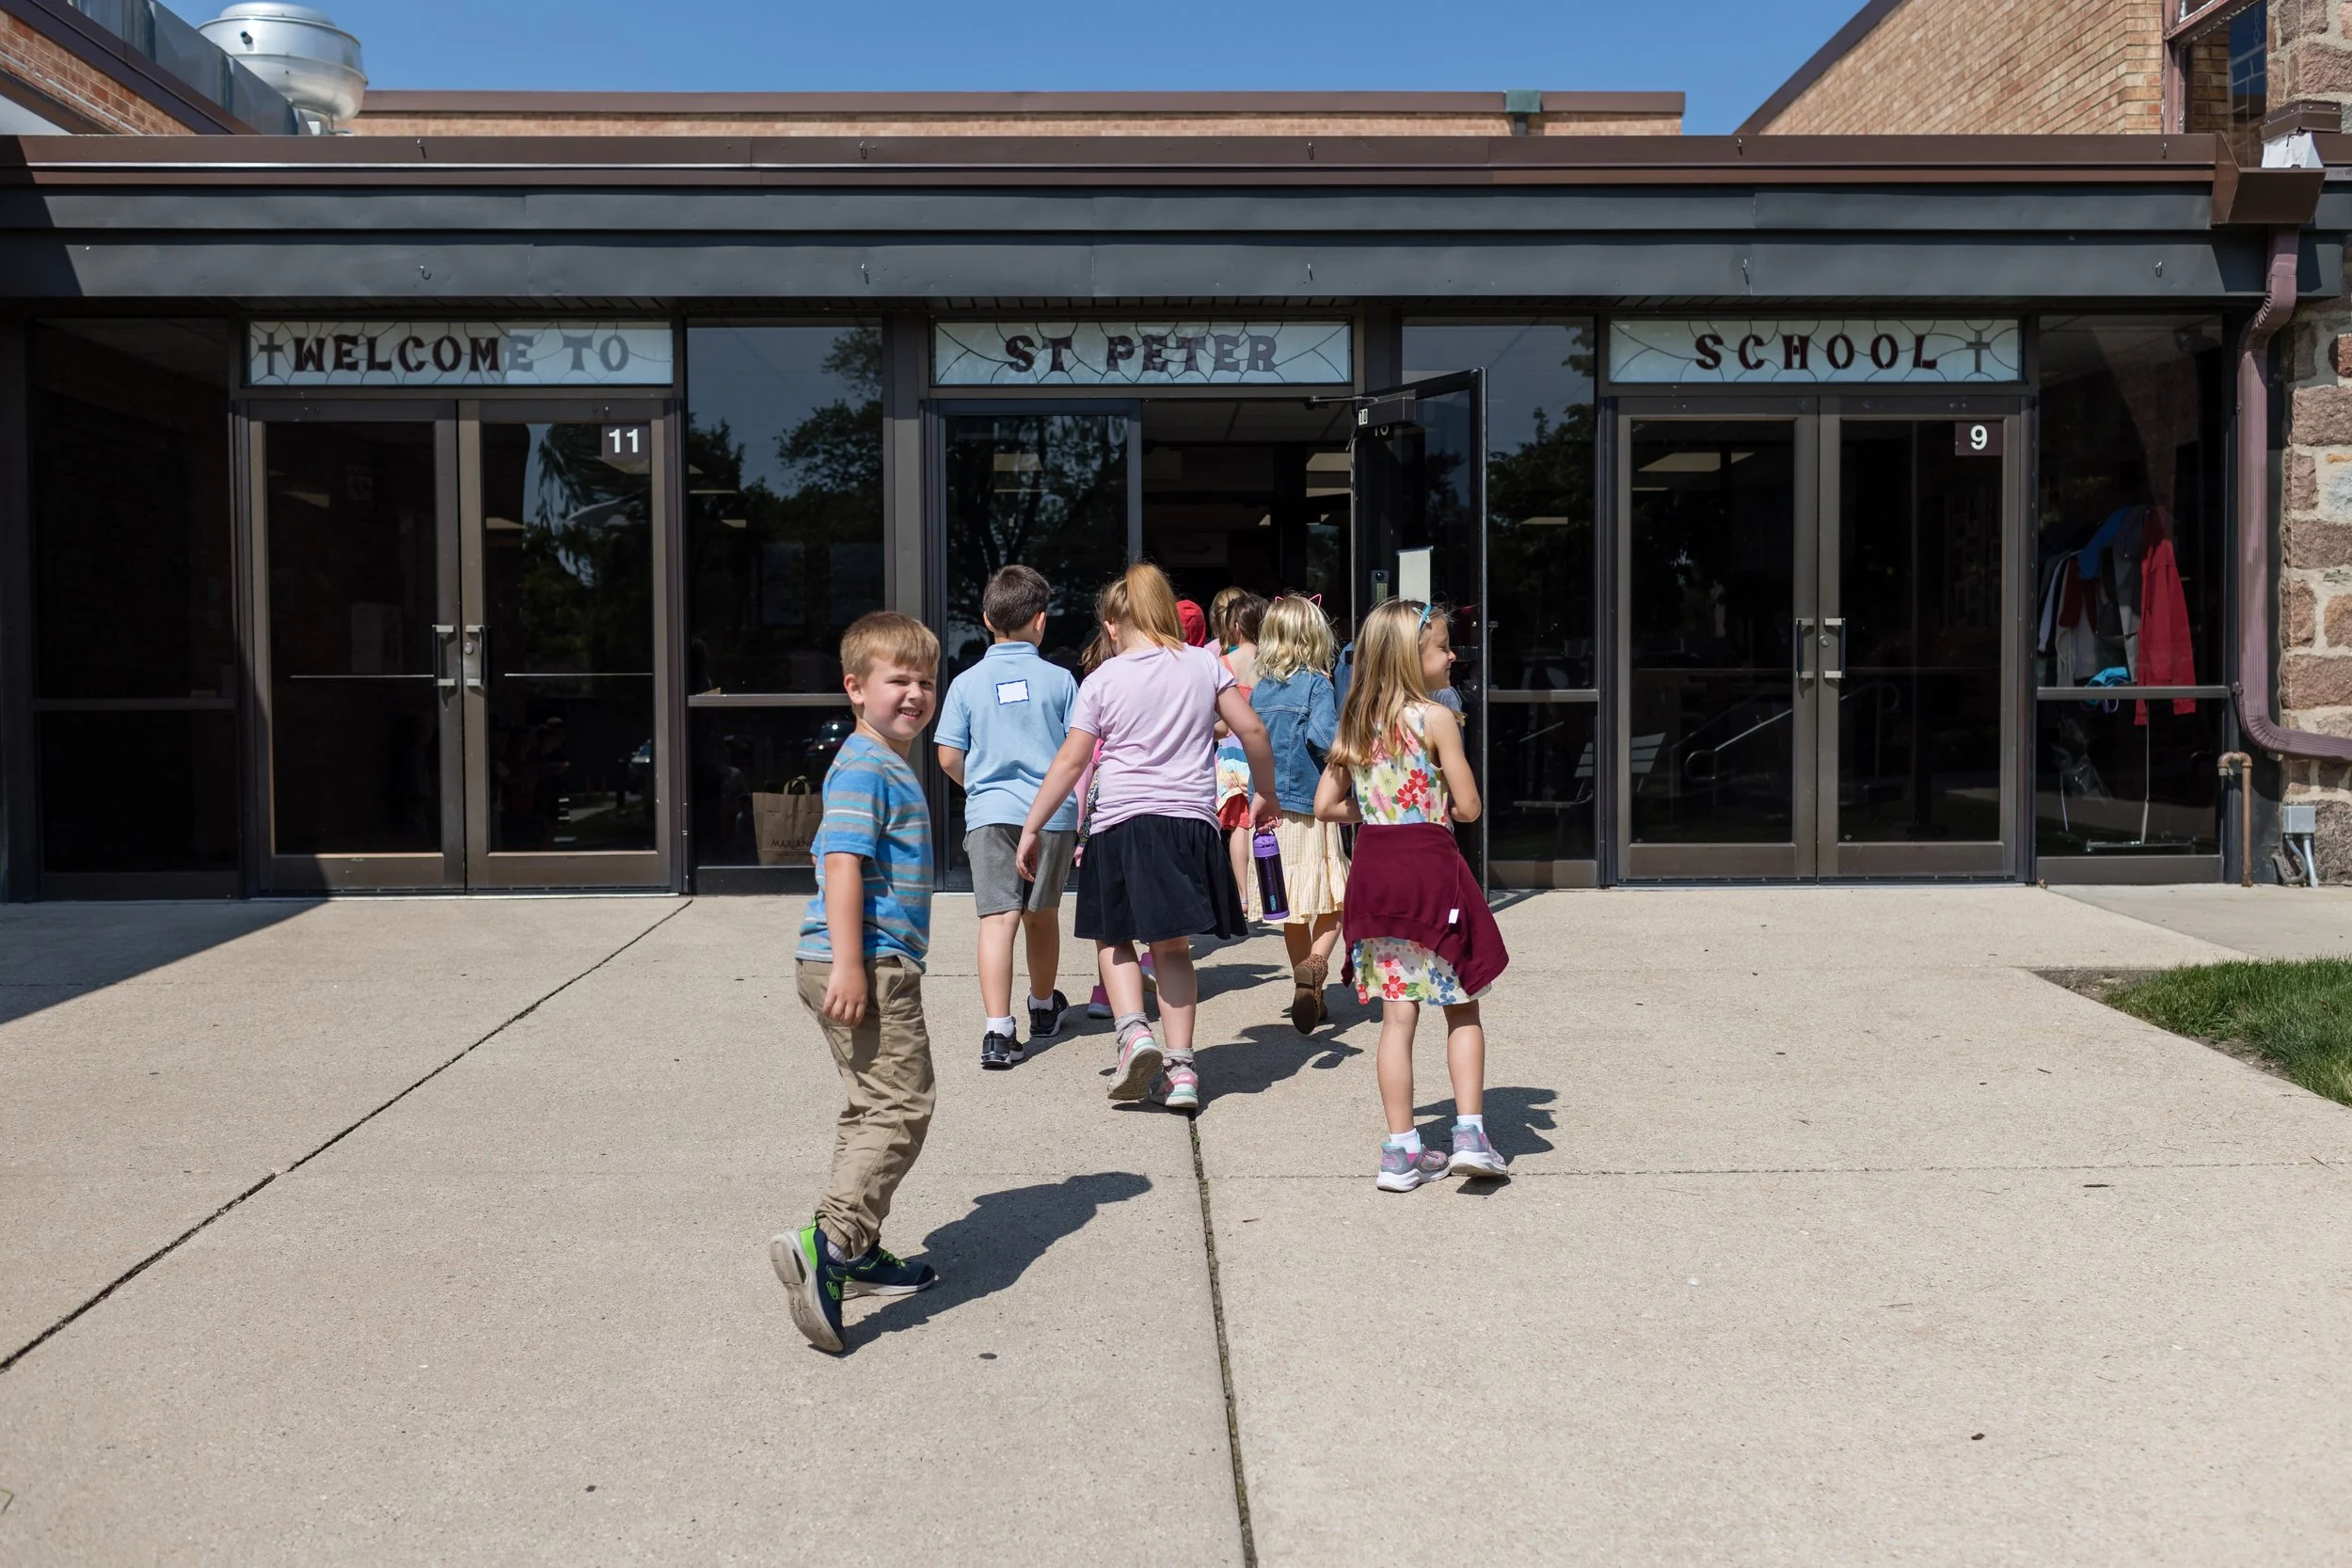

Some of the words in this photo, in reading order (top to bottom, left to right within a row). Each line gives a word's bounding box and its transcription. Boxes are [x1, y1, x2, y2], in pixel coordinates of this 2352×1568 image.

[293, 334, 534, 372] WELCOME
[563, 335, 629, 372] TO
[1005, 335, 1073, 373] ST
[1106, 335, 1278, 373] PETER
[1694, 334, 1938, 370] SCHOOL
[1359, 408, 1368, 425] 10
[608, 428, 639, 453] 11
[1971, 424, 1988, 451] 9
